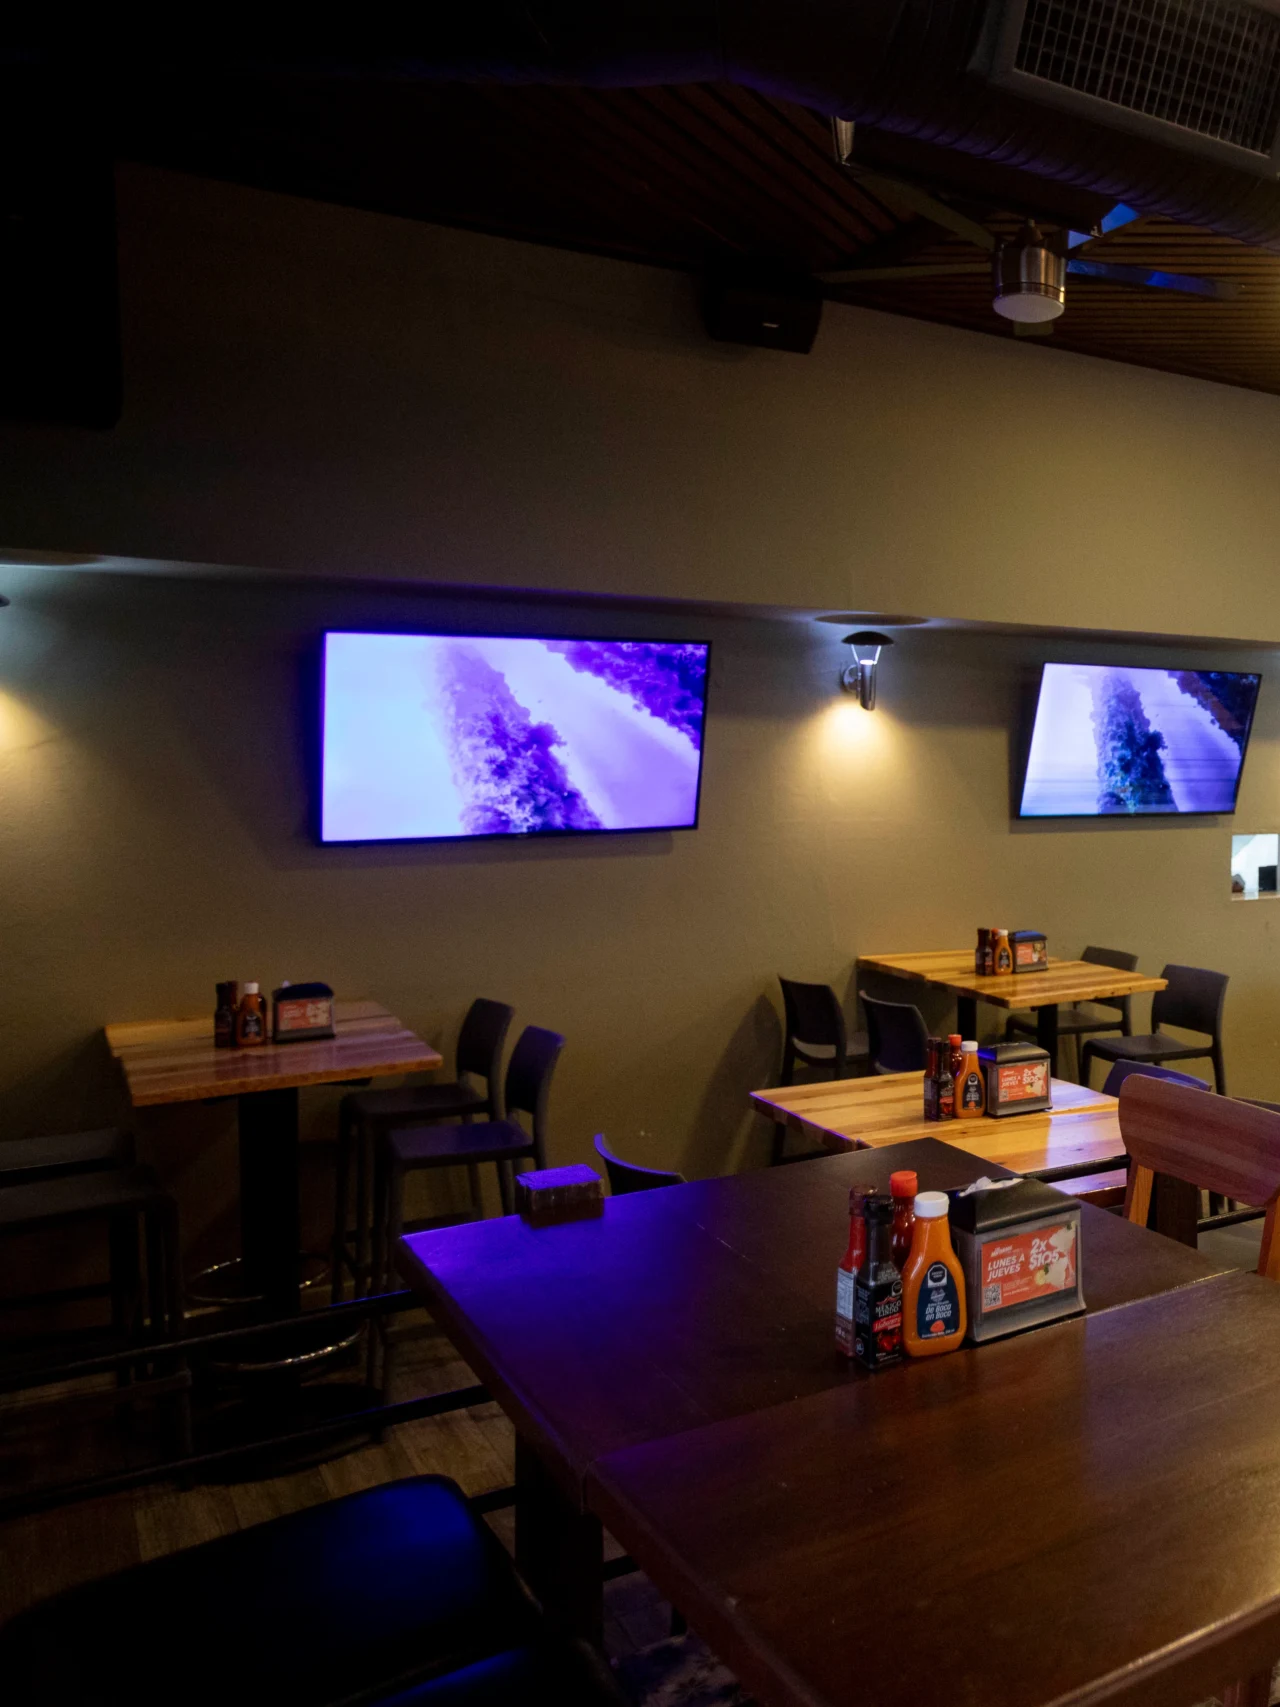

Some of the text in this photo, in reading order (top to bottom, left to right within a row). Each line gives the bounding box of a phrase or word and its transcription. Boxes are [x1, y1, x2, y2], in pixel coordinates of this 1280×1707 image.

[1030, 1238, 1047, 1255] 2x
[987, 1253, 1025, 1271] LUNES A
[1028, 1249, 1060, 1271] $105
[986, 1263, 1021, 1282] JUEVES
